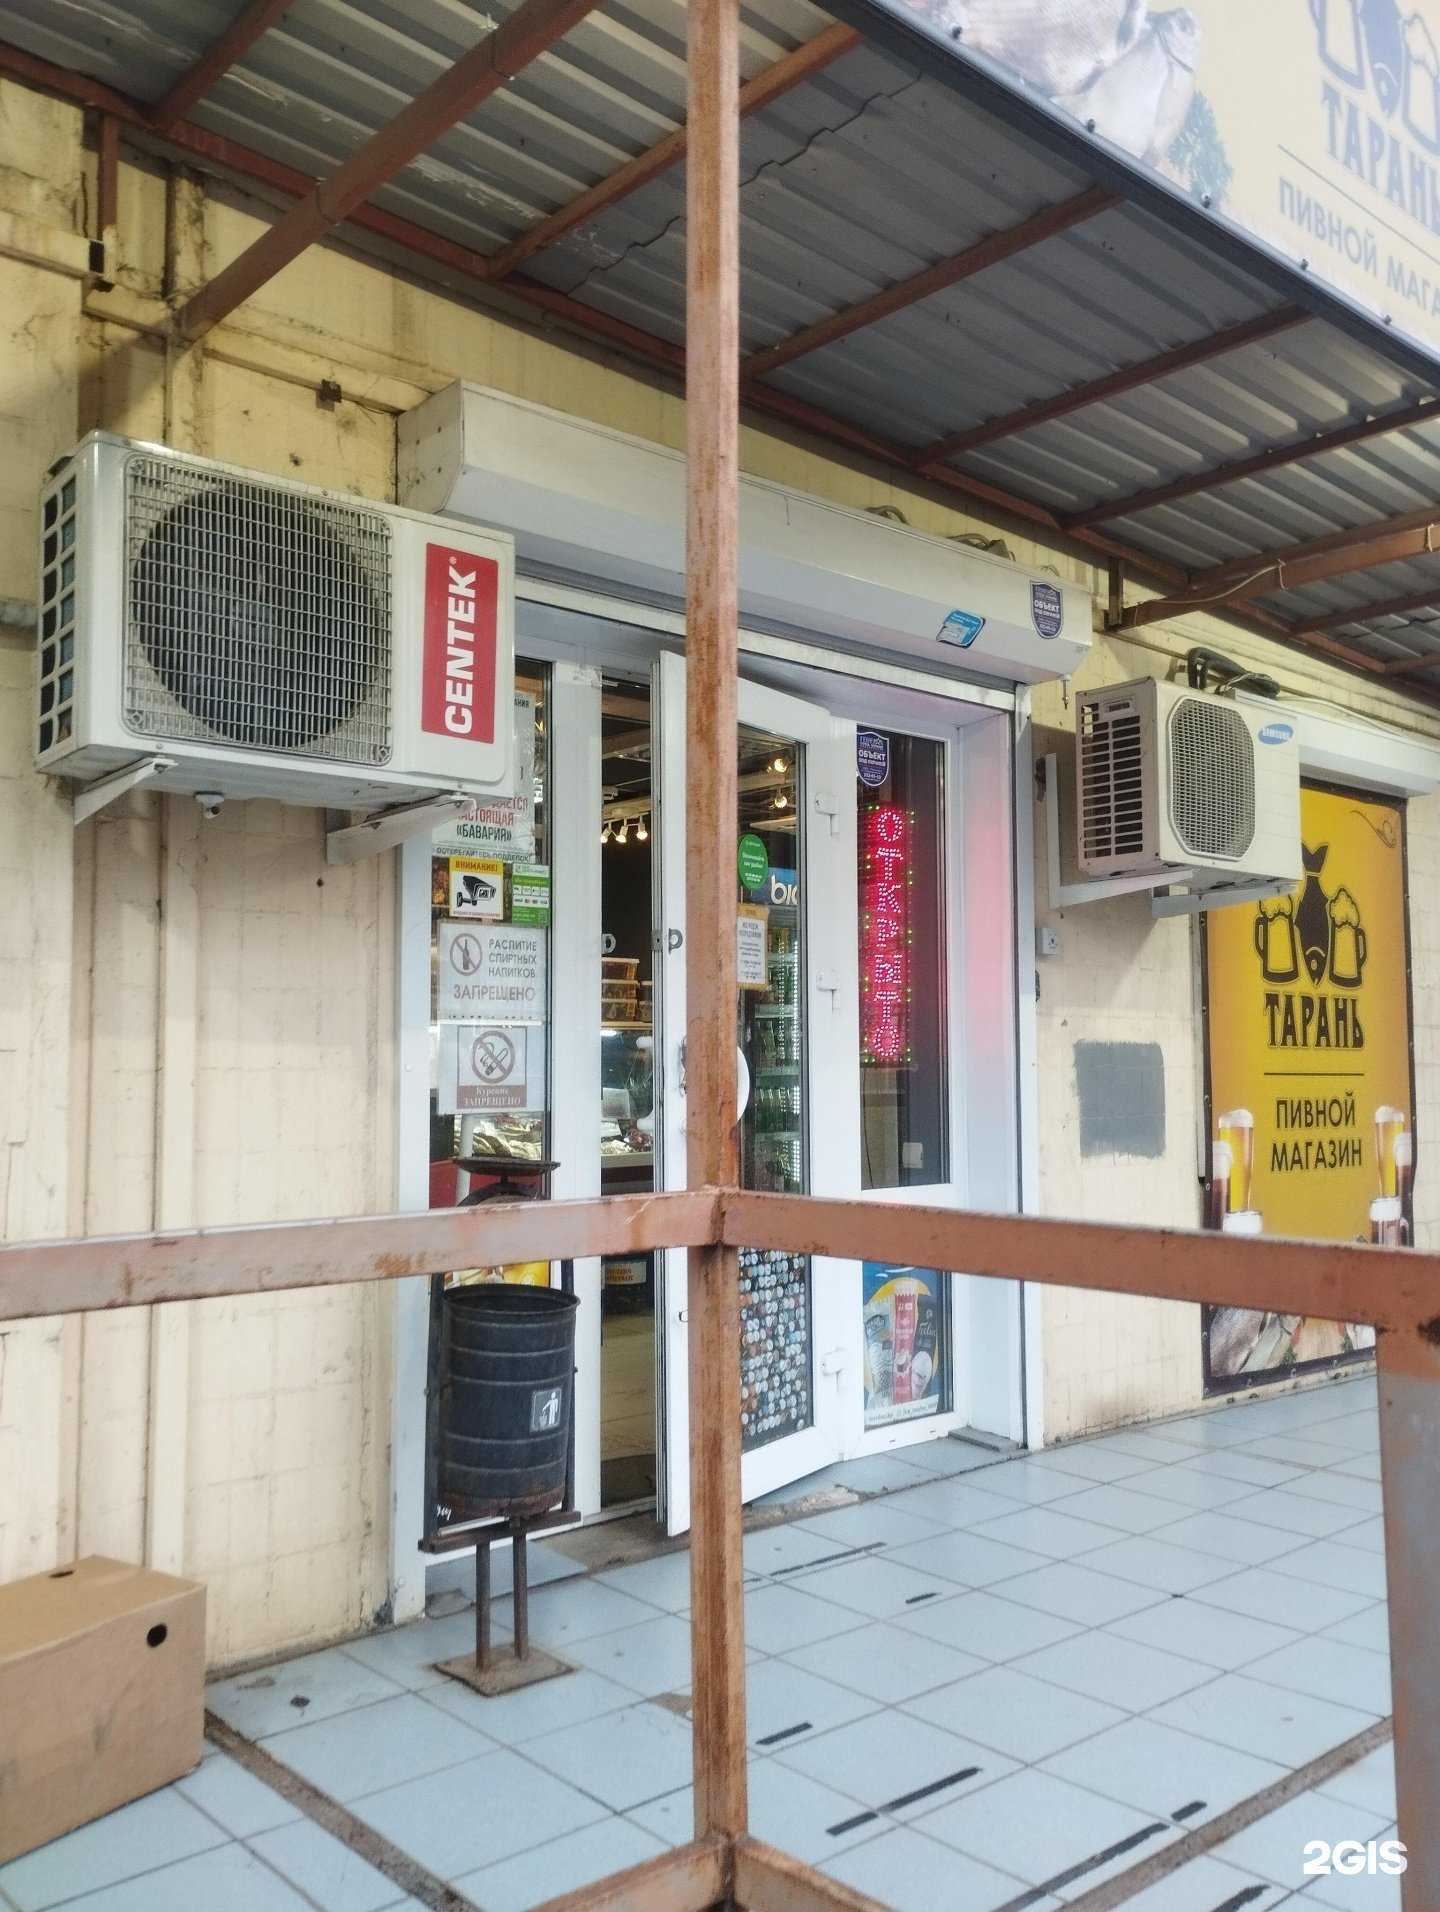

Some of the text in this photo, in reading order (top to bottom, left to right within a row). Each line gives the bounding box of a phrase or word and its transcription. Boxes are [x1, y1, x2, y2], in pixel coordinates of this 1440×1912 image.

[1279, 176, 1377, 278] ПИВНОЙ
[445, 570, 477, 735] CENTEK
[488, 938, 537, 952] РАСПИТИЕ
[872, 810, 903, 1058] ОТКРЫТО
[488, 952, 537, 965] СПИРТНЫХ
[488, 967, 536, 978] НАПИТКОВ
[453, 983, 536, 1002] ЗАПРЕЩЕНО
[1265, 992, 1364, 1049] ТАРАНЬ
[1276, 1091, 1356, 1129] ПИВНОЙ
[1271, 1139, 1362, 1172] МАГАЗИН
